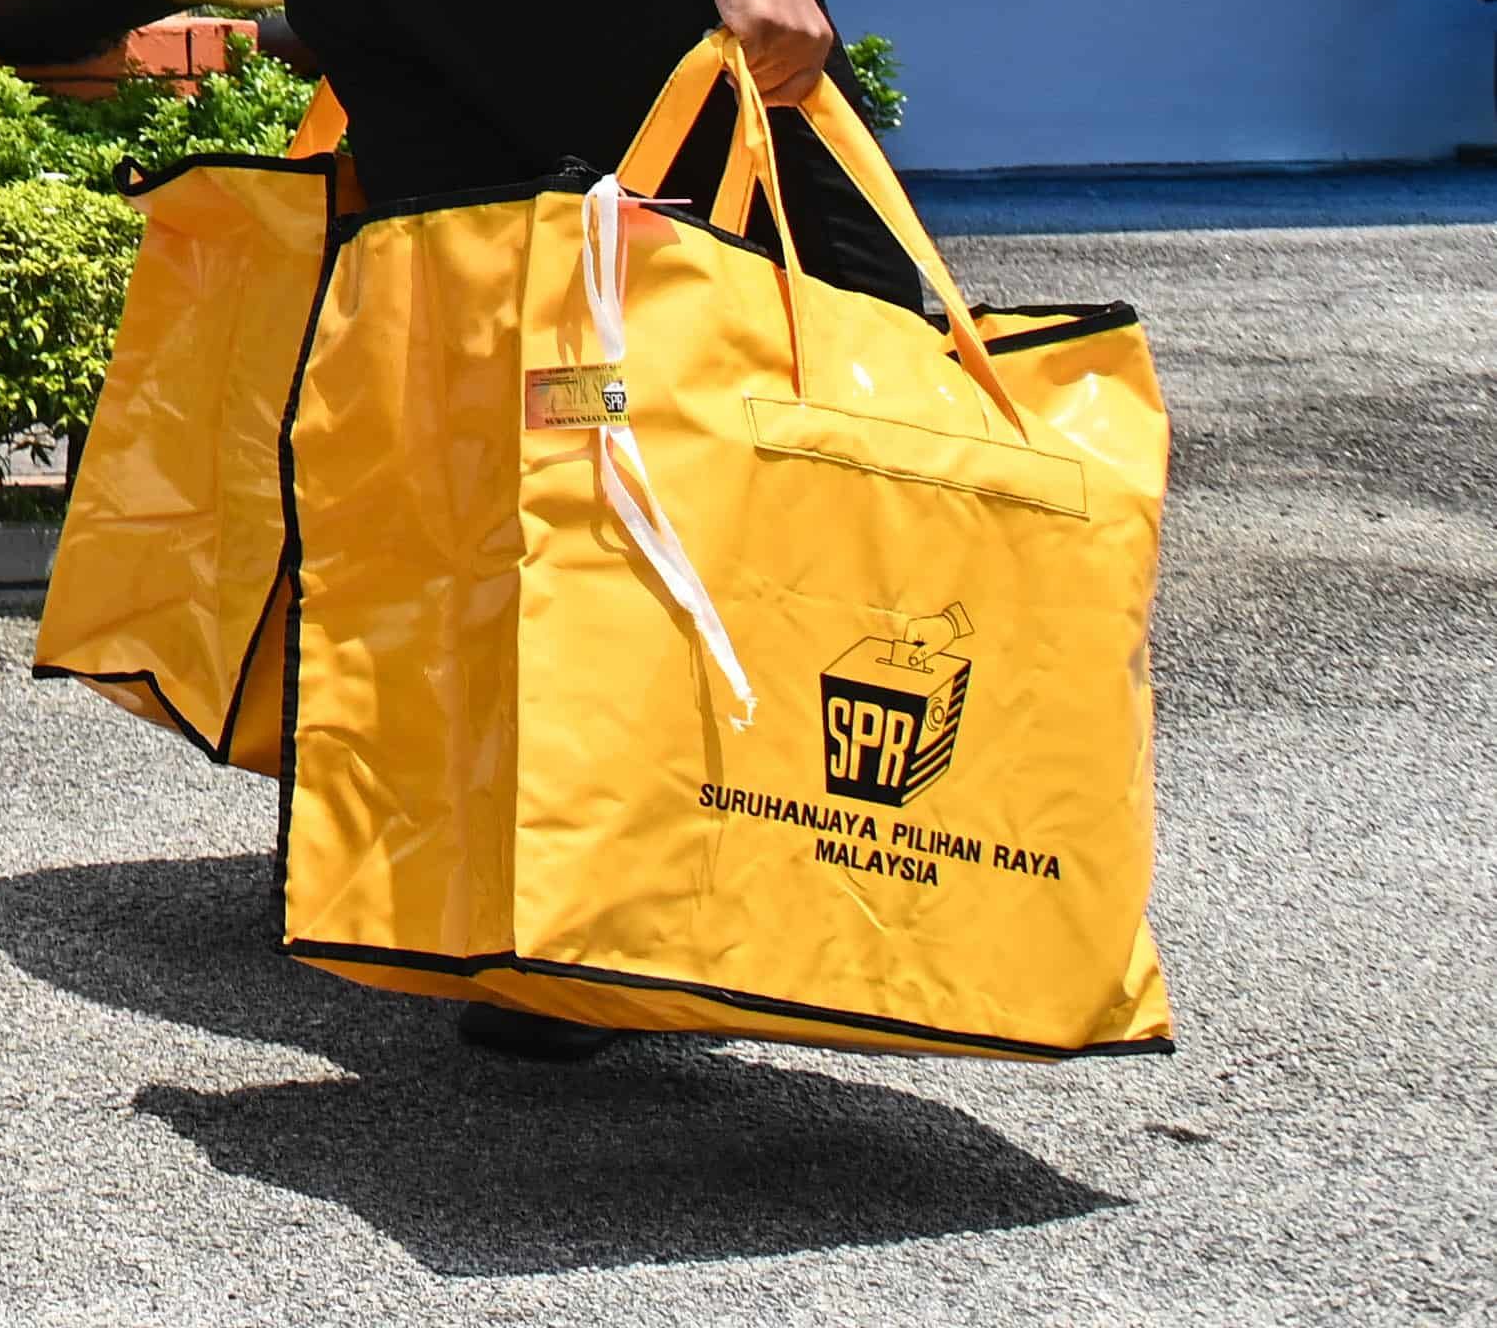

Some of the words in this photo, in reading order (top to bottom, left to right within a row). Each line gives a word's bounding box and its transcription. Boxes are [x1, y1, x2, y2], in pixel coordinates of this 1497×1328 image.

[826, 697, 915, 788] SPR
[698, 783, 878, 842] SURUHANJAYA
[891, 822, 983, 863] PILIHAN
[993, 847, 1061, 880] RAYA
[814, 838, 939, 887] MALAYSIA
